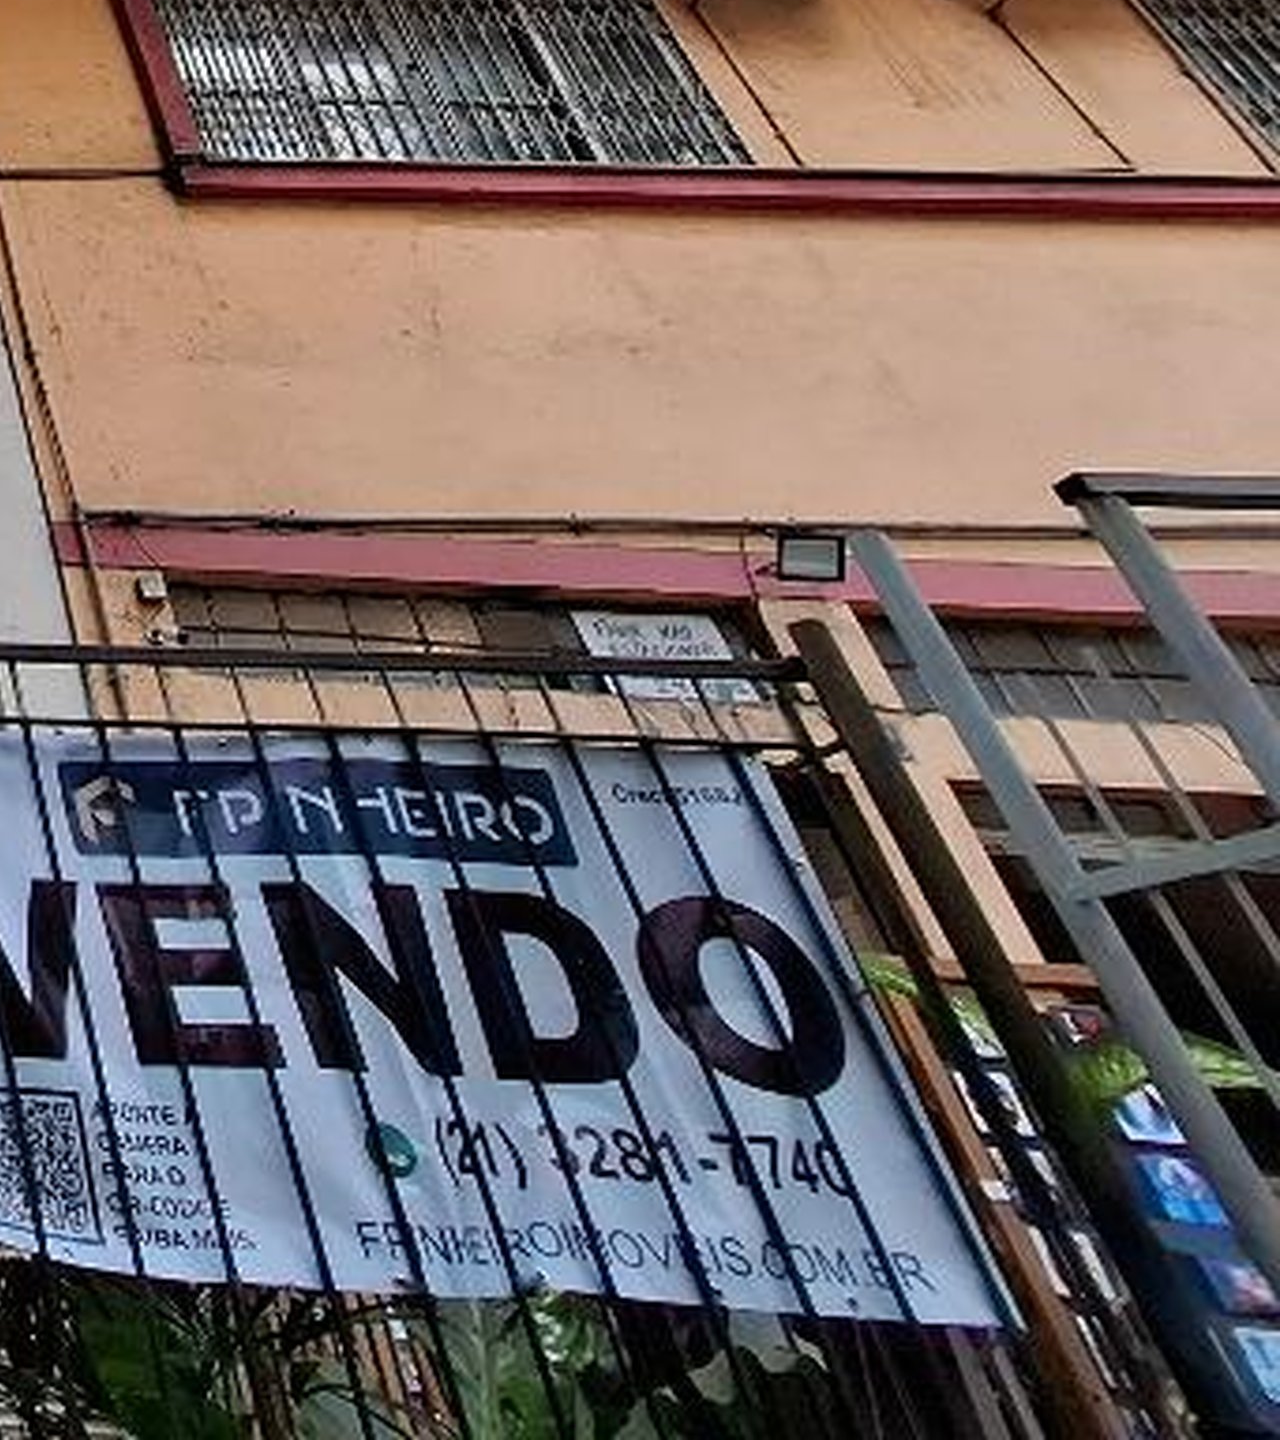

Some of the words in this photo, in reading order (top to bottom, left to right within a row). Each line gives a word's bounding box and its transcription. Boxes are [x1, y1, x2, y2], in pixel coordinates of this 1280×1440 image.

[612, 782, 671, 804] Crec
[173, 786, 554, 845] FPNHEIRO
[435, 1114, 528, 1194] (21)
[113, 1224, 190, 1250] SIBA
